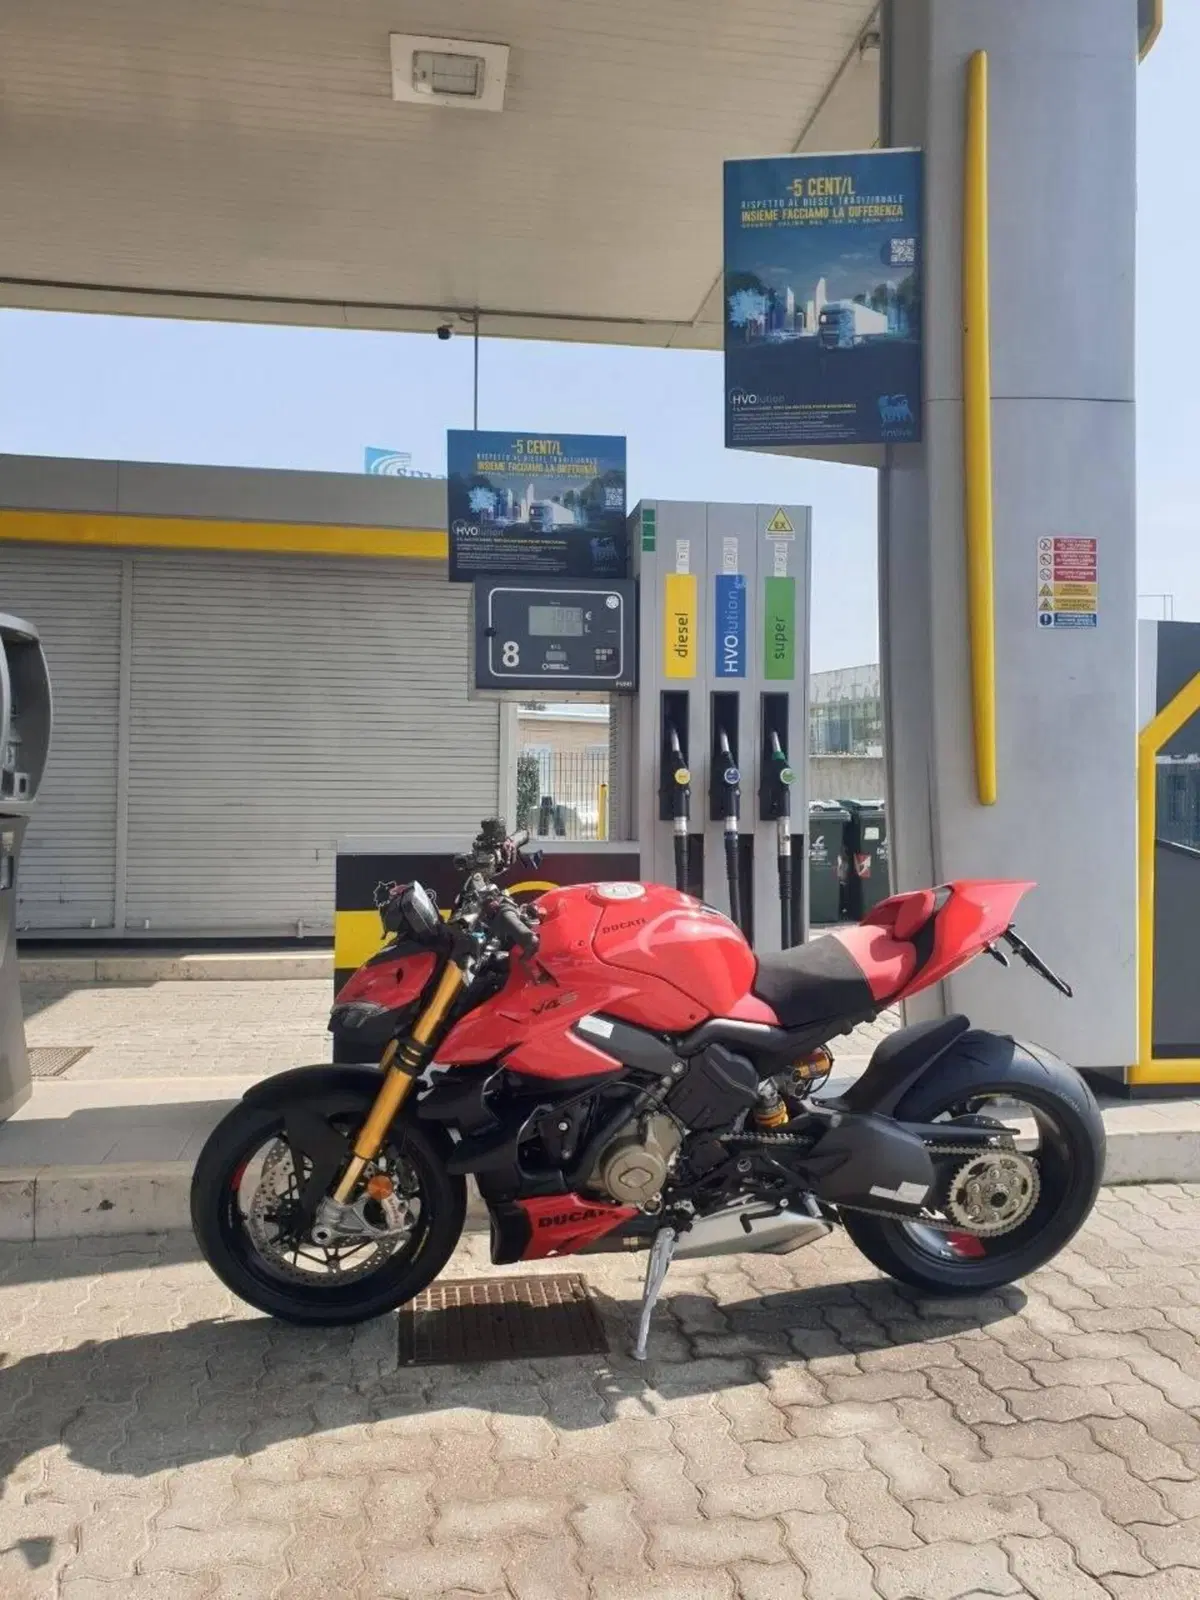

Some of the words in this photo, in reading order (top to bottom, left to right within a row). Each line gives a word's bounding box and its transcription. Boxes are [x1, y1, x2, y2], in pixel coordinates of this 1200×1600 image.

[785, 178, 802, 197] -5
[808, 176, 856, 196] CENT/L
[741, 199, 785, 209] RISPETTO
[788, 198, 800, 207] AL
[803, 196, 834, 206] DIESEL
[741, 210, 779, 223] INSIEME
[782, 208, 829, 220] FACCIAMO
[832, 208, 845, 218] LA
[849, 204, 904, 217] DIFFERENZA
[732, 393, 786, 405] HVOlution
[511, 439, 524, 454] -5
[527, 440, 563, 455] CENT/L
[774, 521, 786, 529] EX
[675, 612, 688, 658] diesel
[724, 590, 739, 672] HVOlution
[775, 616, 788, 659] super
[502, 641, 520, 667] 8
[602, 917, 646, 934] DUCATI
